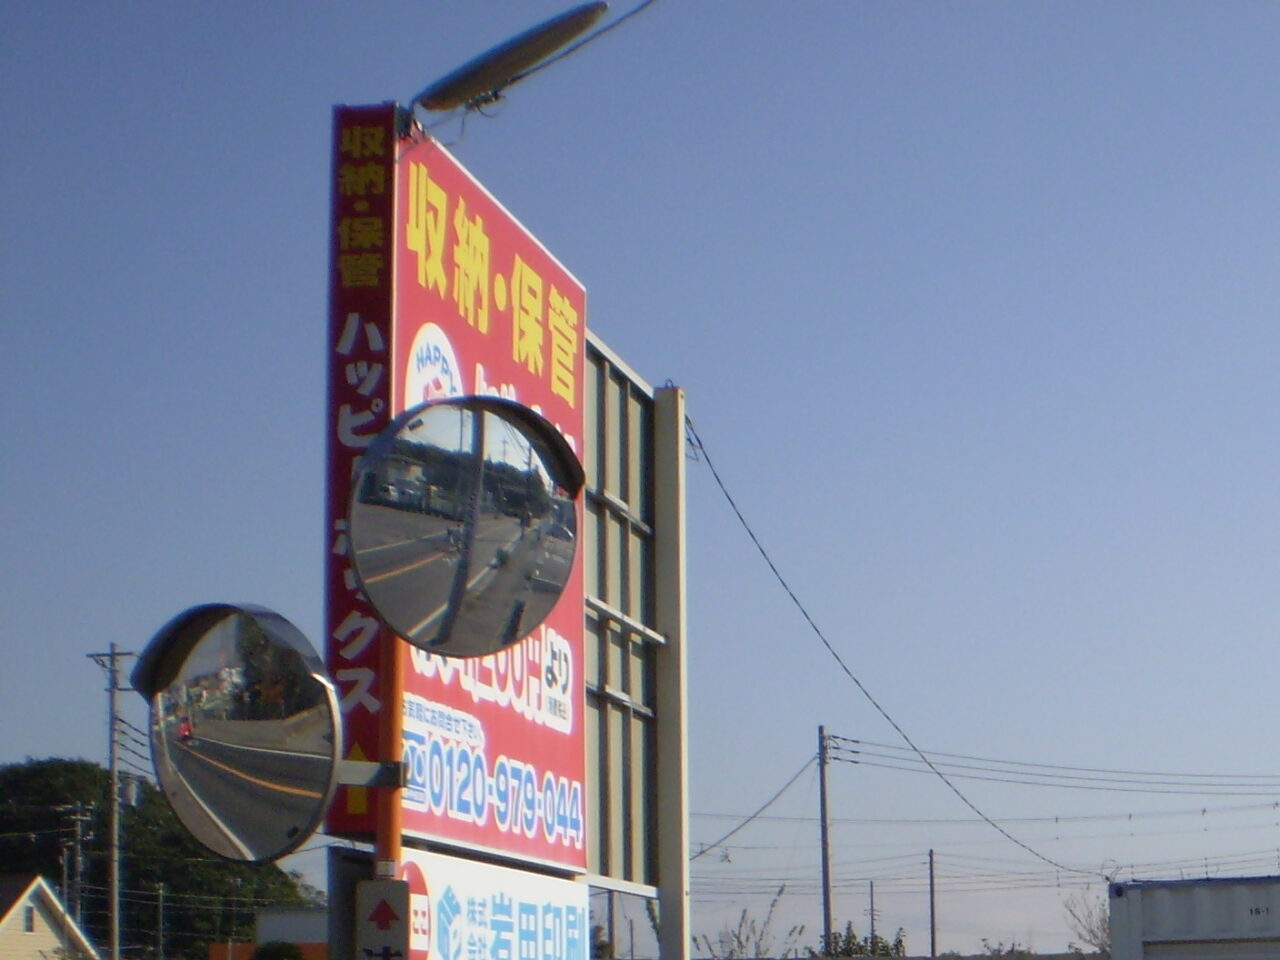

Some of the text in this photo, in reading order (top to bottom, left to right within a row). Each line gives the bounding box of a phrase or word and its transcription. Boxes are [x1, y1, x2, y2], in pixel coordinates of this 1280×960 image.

[339, 125, 386, 288] 収納・保管
[406, 161, 578, 408] 収納・保管
[545, 640, 569, 695] より
[429, 740, 581, 843] 0120-979-044
